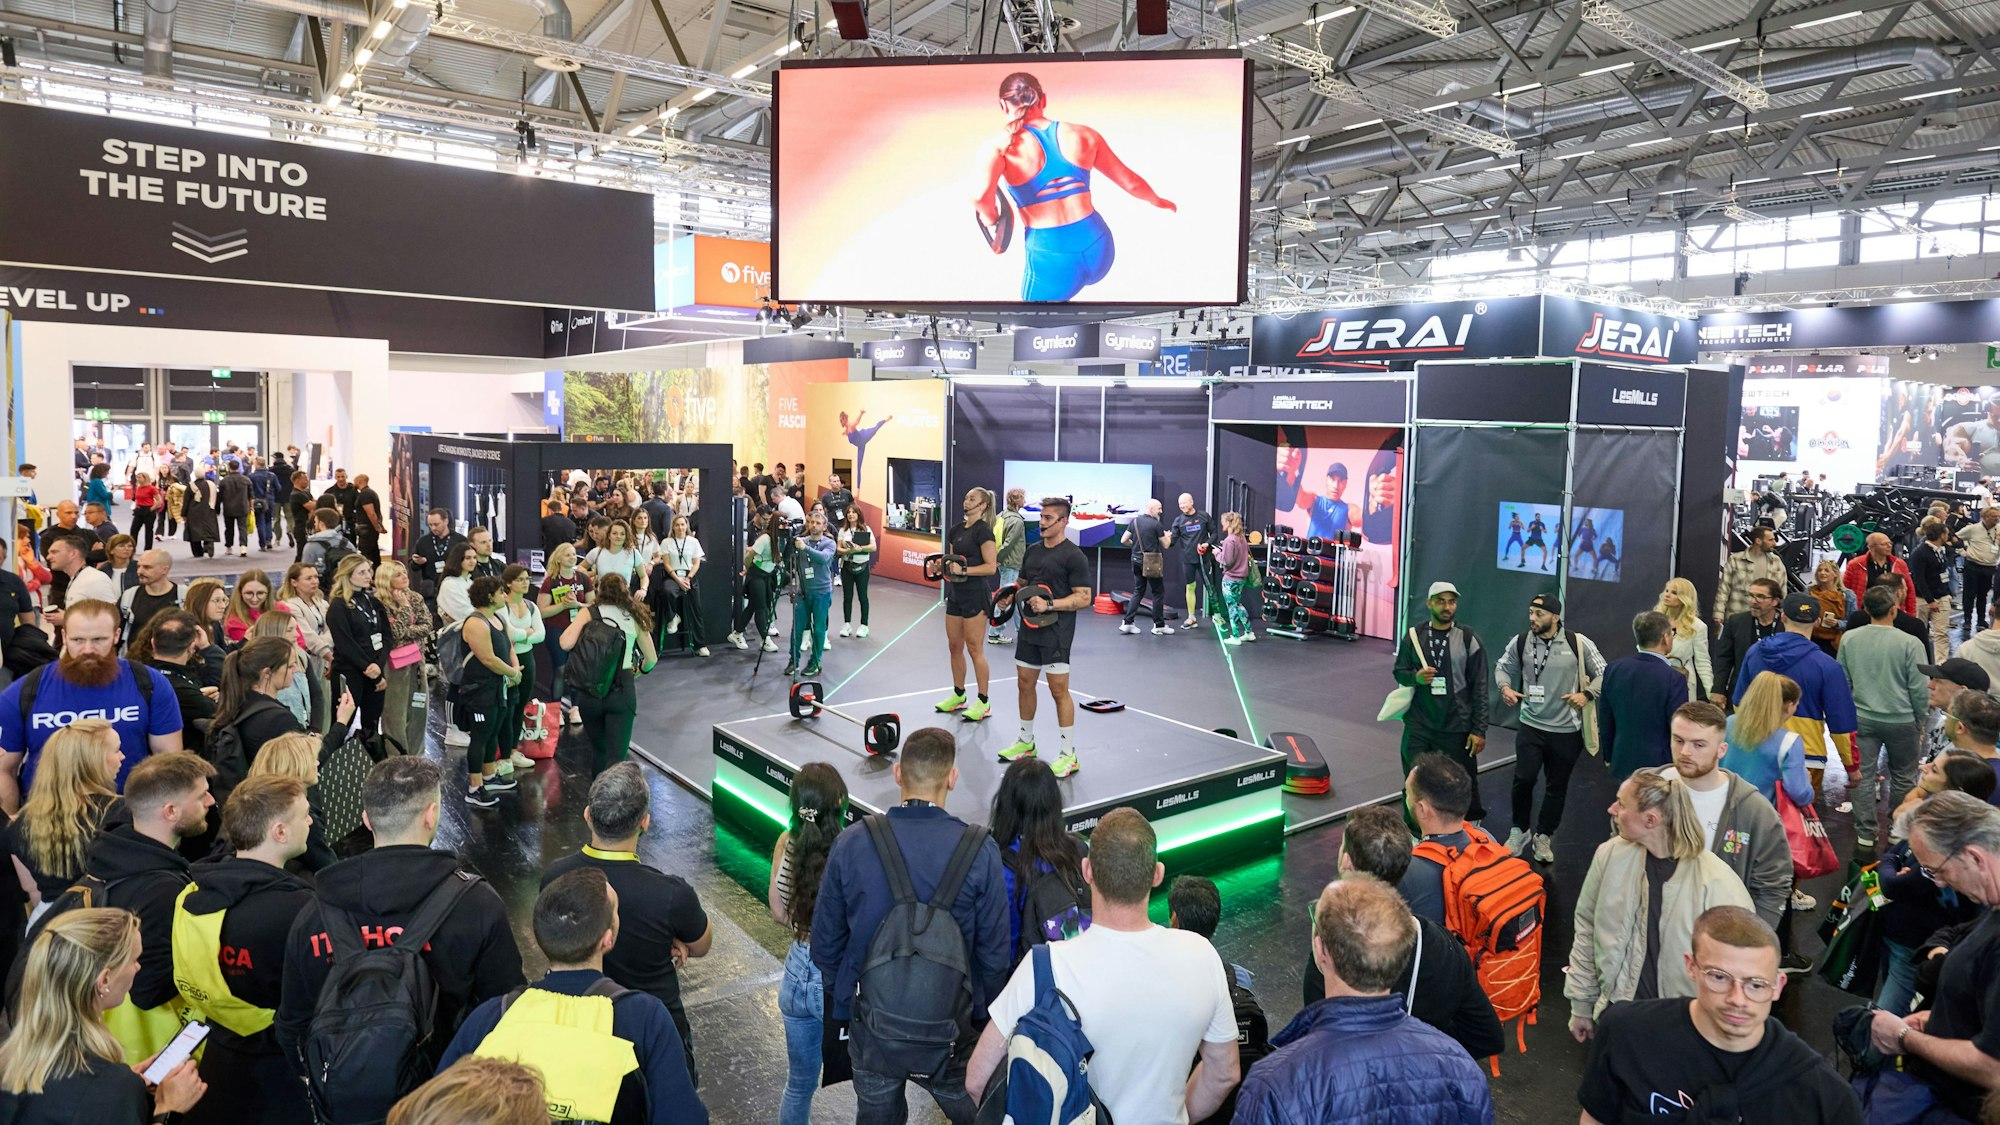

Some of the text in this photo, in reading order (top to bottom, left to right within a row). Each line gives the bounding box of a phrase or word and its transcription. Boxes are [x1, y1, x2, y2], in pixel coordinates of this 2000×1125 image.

[102, 138, 309, 187] STEP INTO
[79, 168, 327, 221] THE FUTURE
[0, 286, 131, 313] EVEL UP
[1304, 313, 1474, 353] JERAI
[1581, 317, 1674, 359] JERAI
[1740, 336, 1791, 344] EQUIPMENT
[1797, 364, 1843, 373] POLAR
[778, 397, 798, 411] FIVE
[32, 705, 140, 730] ROGUE
